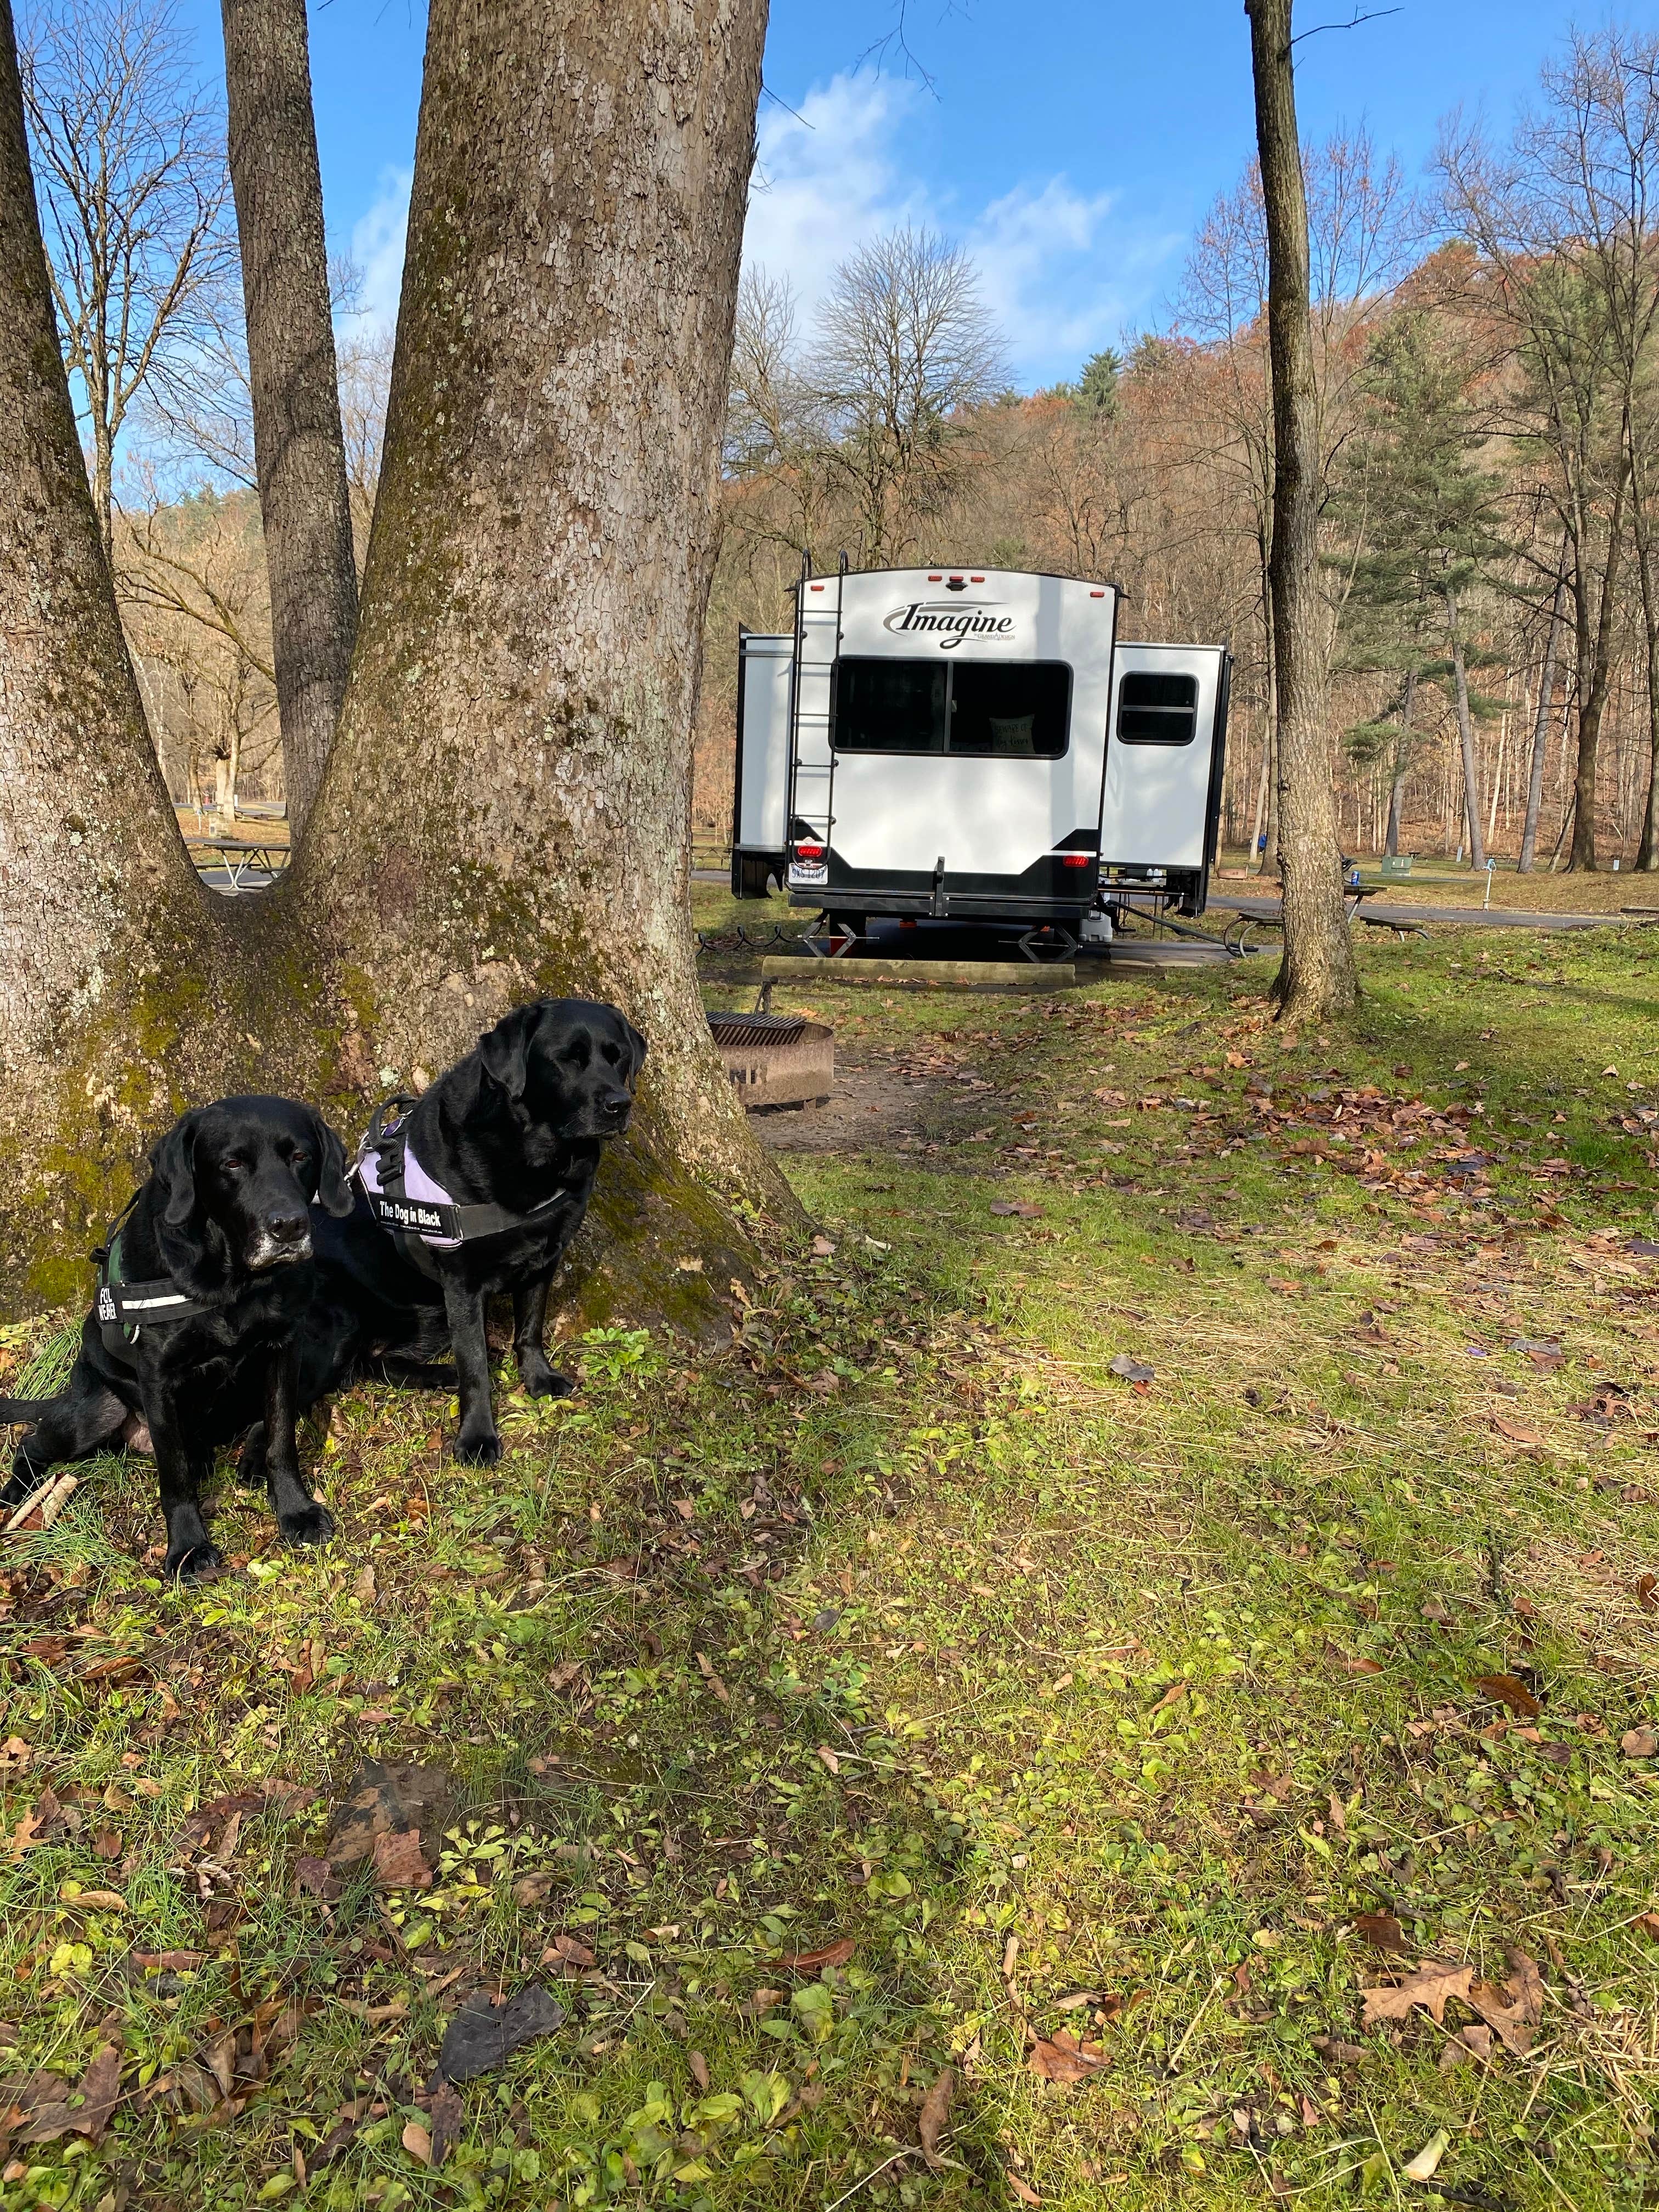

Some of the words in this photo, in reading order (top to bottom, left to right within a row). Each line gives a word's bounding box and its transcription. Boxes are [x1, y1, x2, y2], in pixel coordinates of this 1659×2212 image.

[895, 602, 1017, 650] Imagine
[380, 1200, 393, 1218] The
[394, 1204, 409, 1224] Dog
[410, 1206, 417, 1223] in
[417, 1208, 441, 1227] Black
